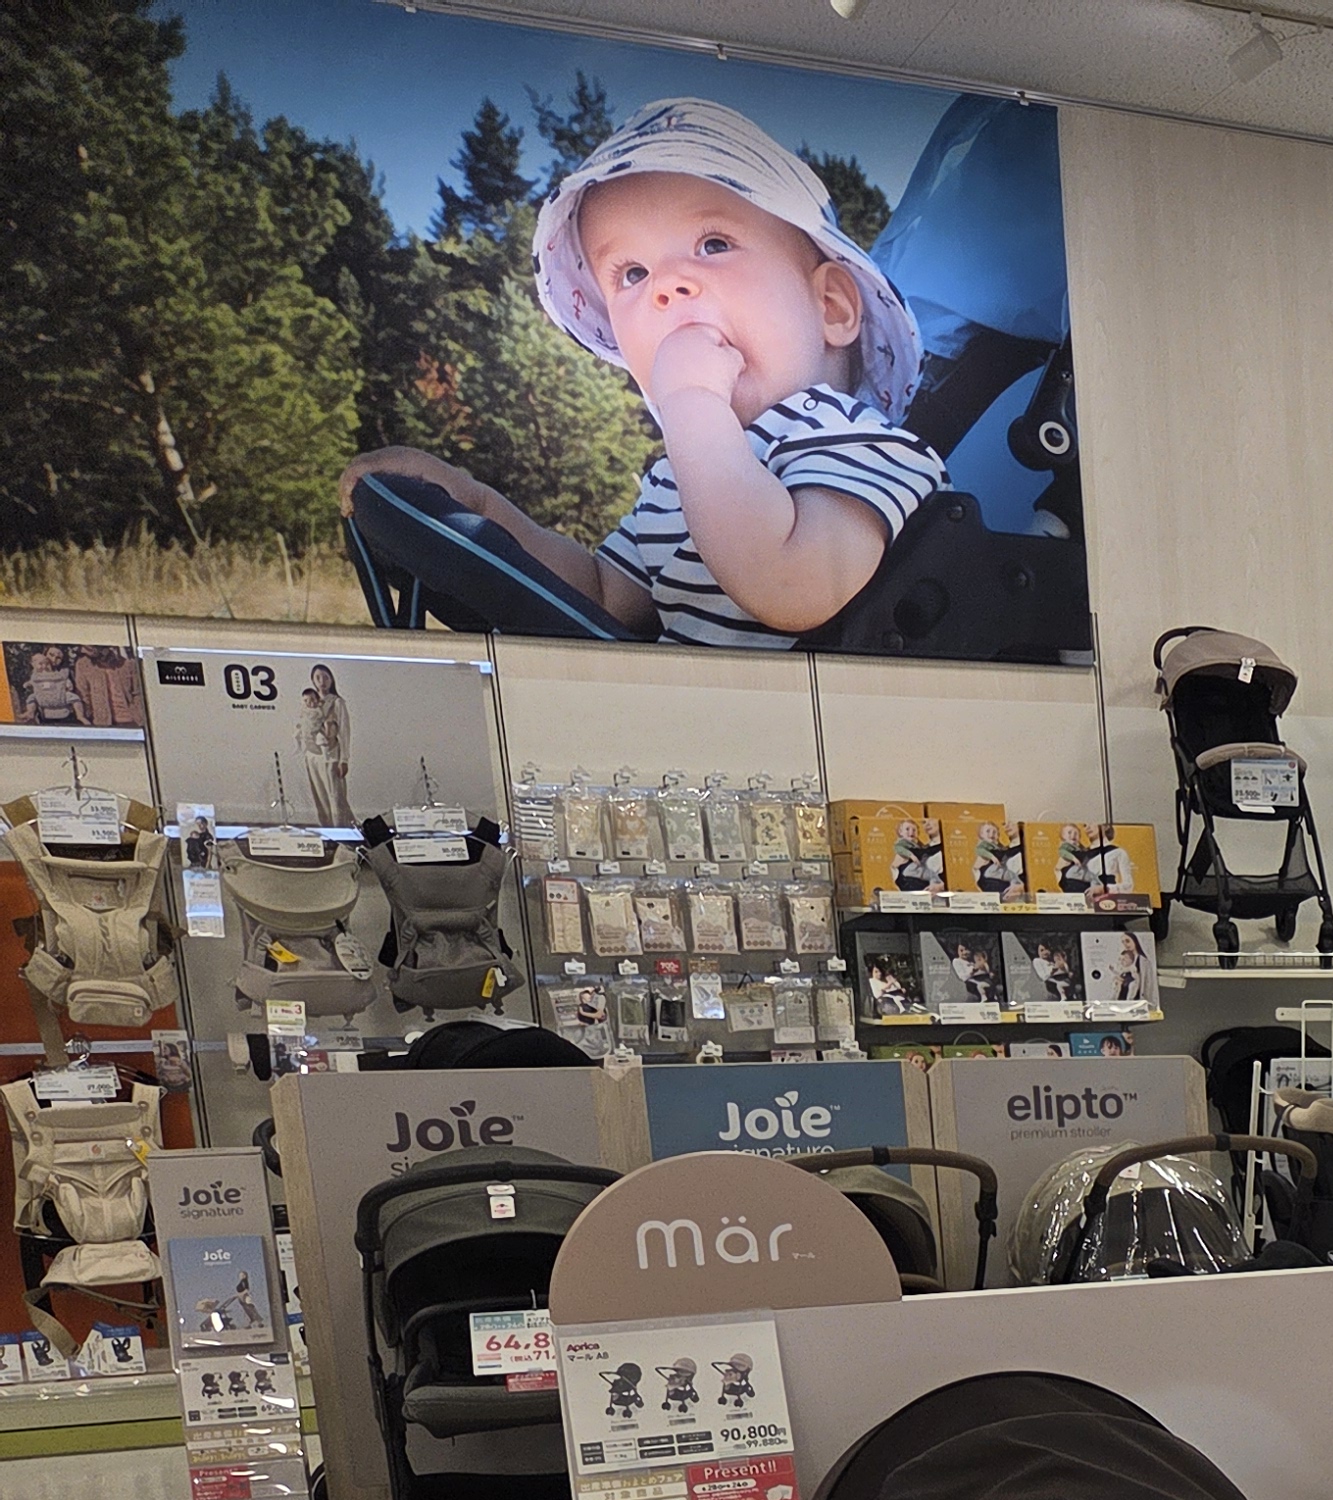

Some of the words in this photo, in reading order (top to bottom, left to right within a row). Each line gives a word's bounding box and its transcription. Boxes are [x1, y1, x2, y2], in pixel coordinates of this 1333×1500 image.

[224, 664, 278, 701] 03
[719, 1091, 832, 1141] Joie
[1007, 1085, 1122, 1129] elipto
[387, 1100, 515, 1153] Joie
[1010, 1127, 1073, 1142] premium
[1076, 1126, 1112, 1139] stroller
[179, 1181, 242, 1207] Joie
[180, 1207, 244, 1220] signature
[636, 1215, 793, 1269] mär
[486, 1332, 554, 1351] 64,8
[567, 1342, 600, 1352] Aprica
[721, 1424, 786, 1442] 90,800円
